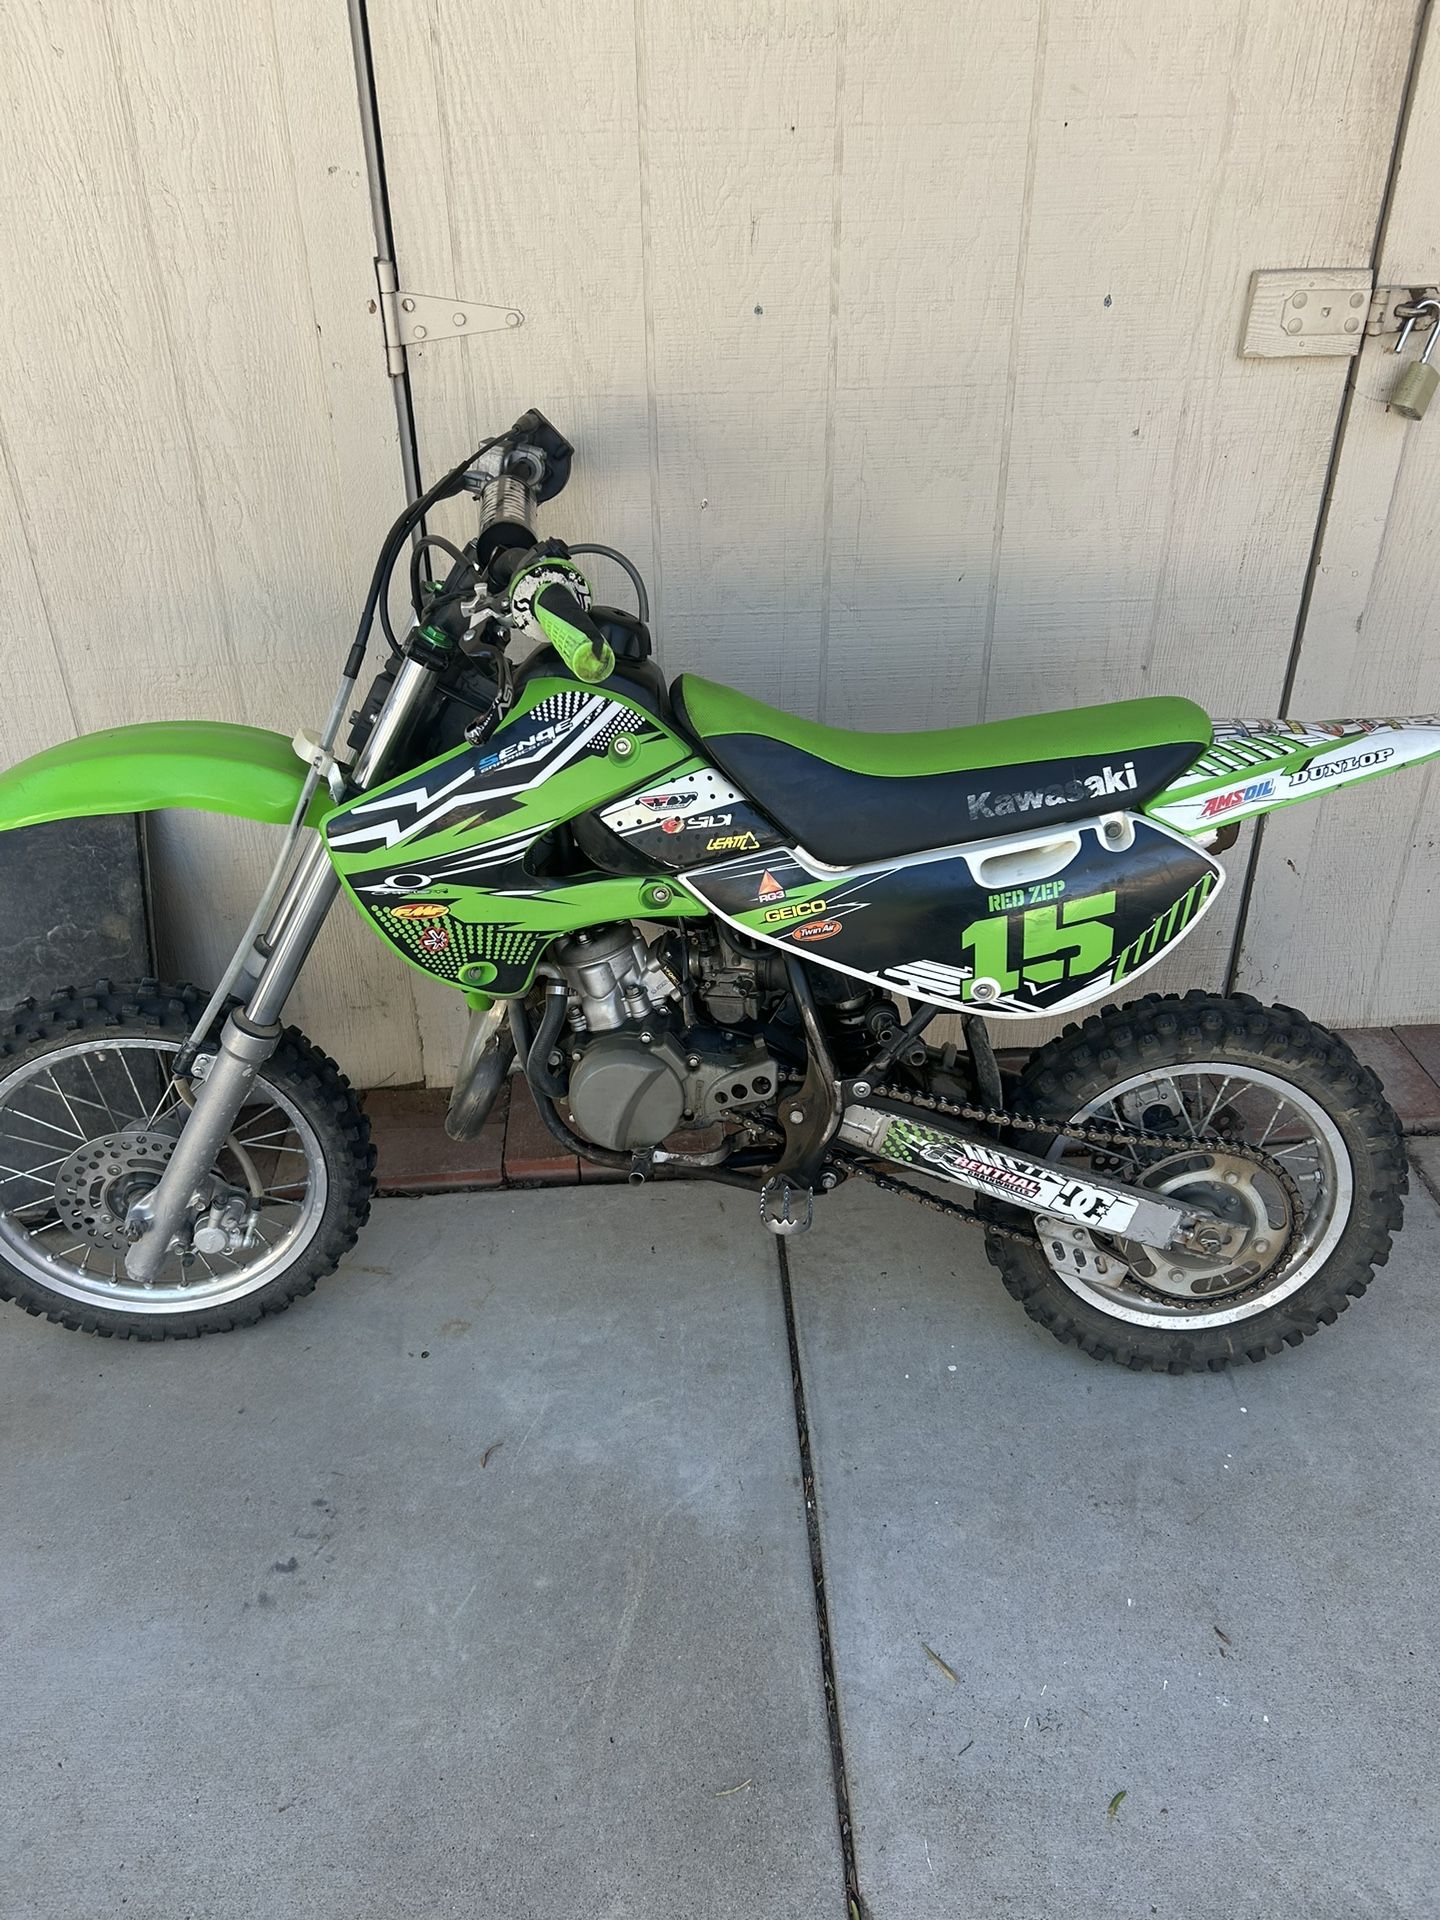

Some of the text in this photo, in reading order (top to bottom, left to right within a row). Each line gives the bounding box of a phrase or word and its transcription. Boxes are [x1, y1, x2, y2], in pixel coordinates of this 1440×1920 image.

[1289, 747, 1395, 787] DUNLOP
[966, 761, 1138, 820] Kawasaki
[1200, 779, 1275, 818] AMSOIL
[686, 813, 733, 830] SIDI
[758, 890, 786, 903] RG3
[988, 879, 1066, 912] RED ZEP
[393, 905, 447, 917] FMF
[764, 899, 827, 923] GEICO
[800, 923, 835, 937] Twin Air
[961, 890, 1117, 1001] 15
[953, 1155, 1040, 1192] RENTHAL
[967, 1170, 1030, 1196] CHAINWHEELS
